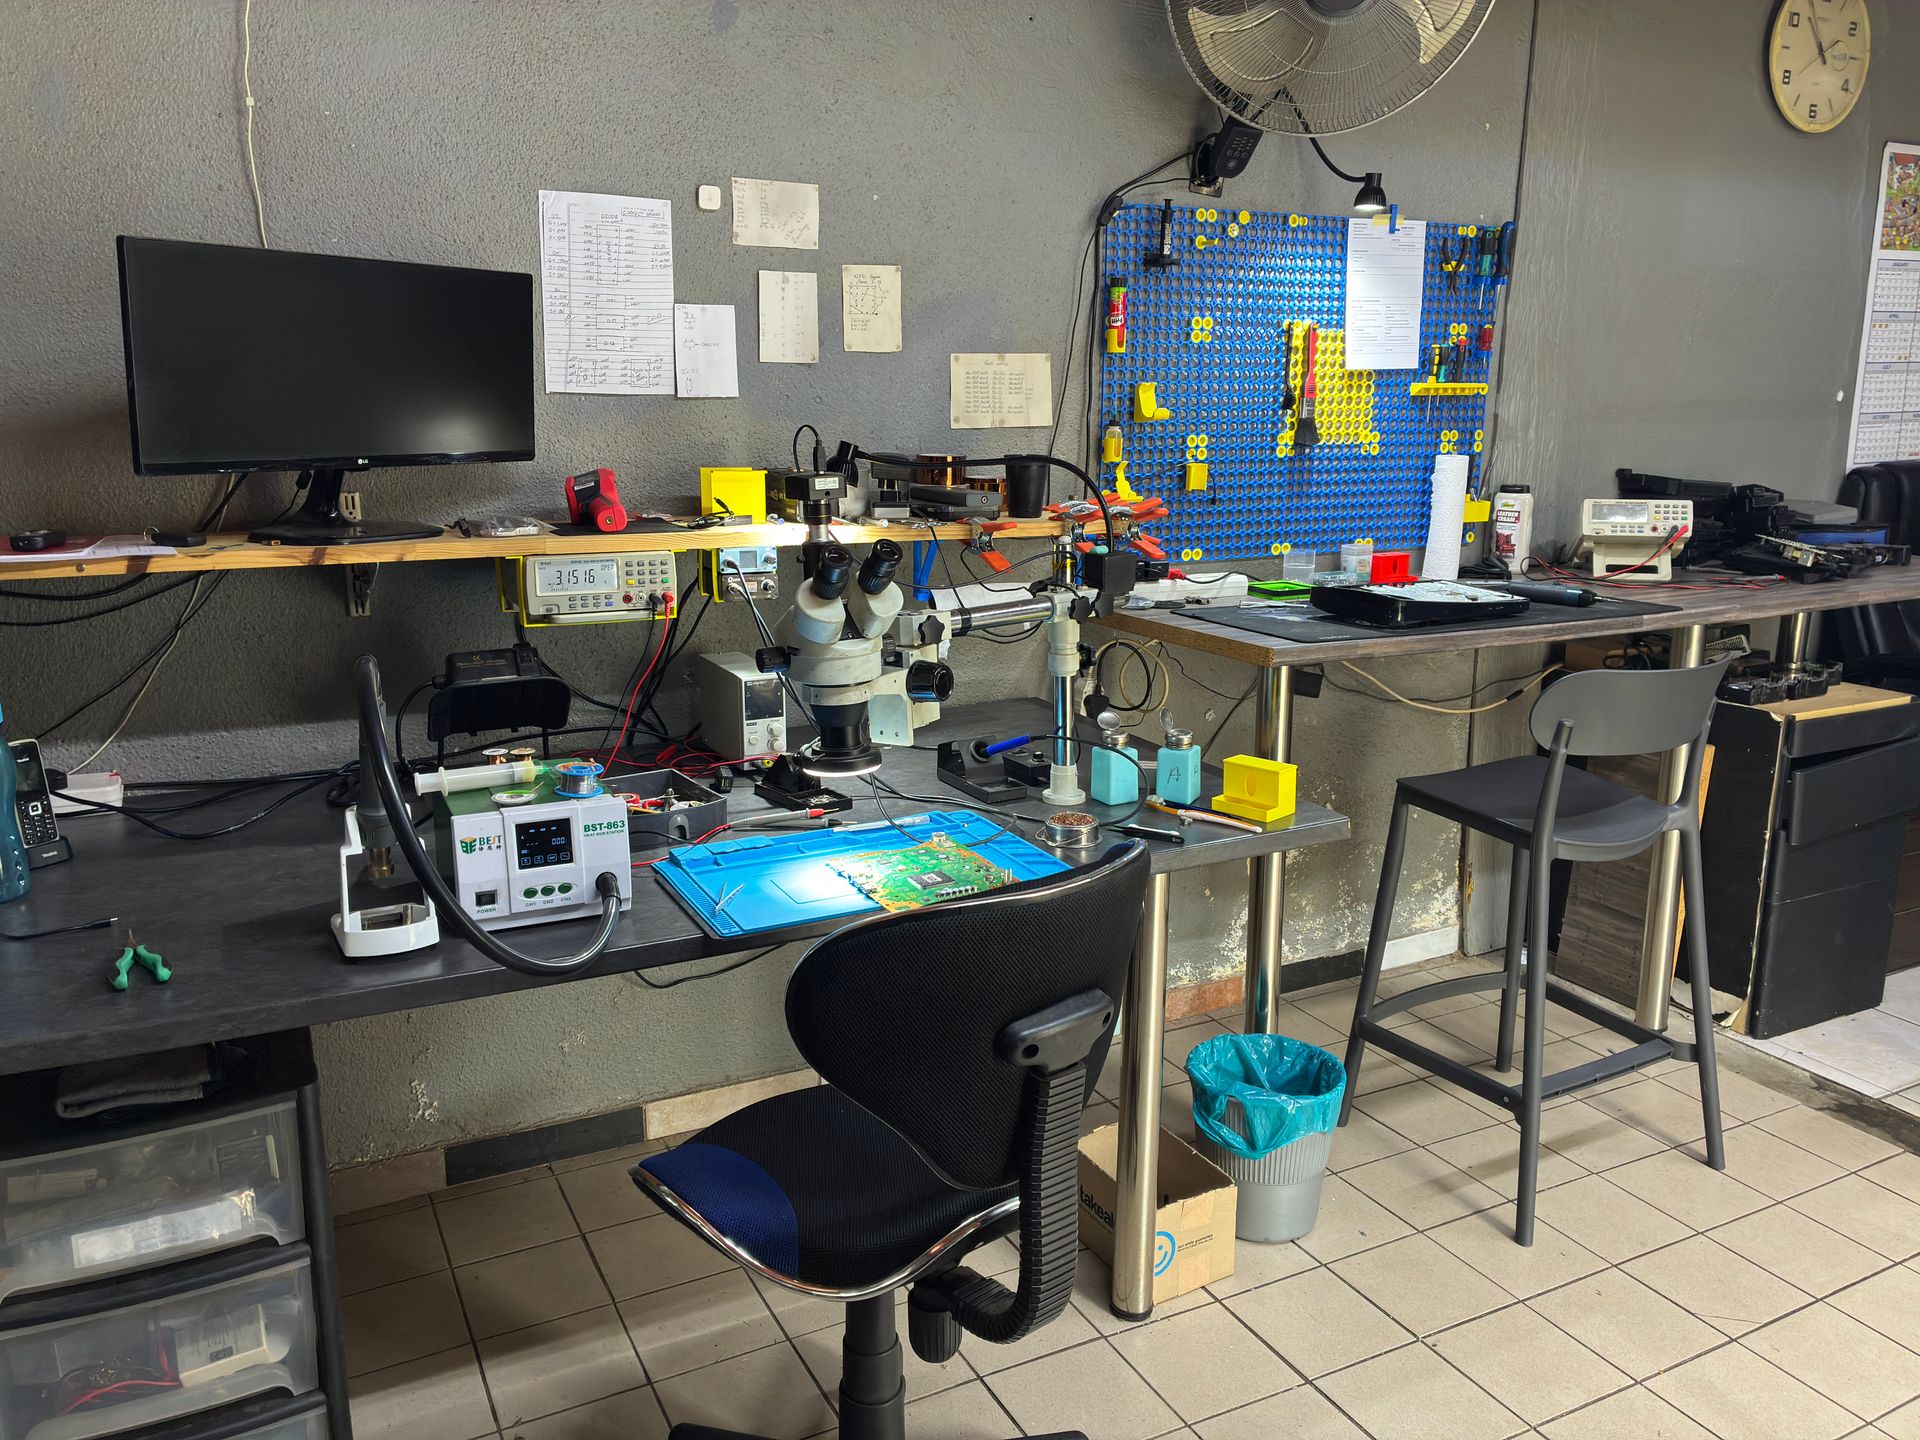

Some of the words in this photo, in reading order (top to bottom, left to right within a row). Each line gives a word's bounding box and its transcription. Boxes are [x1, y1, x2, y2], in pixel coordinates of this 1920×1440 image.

[1848, 21, 1858, 37] 2
[1782, 69, 1791, 85] 8
[1841, 78, 1850, 94] 4
[1808, 103, 1818, 119] 6
[583, 820, 626, 832] BST-863
[1079, 1184, 1114, 1229] takeal
